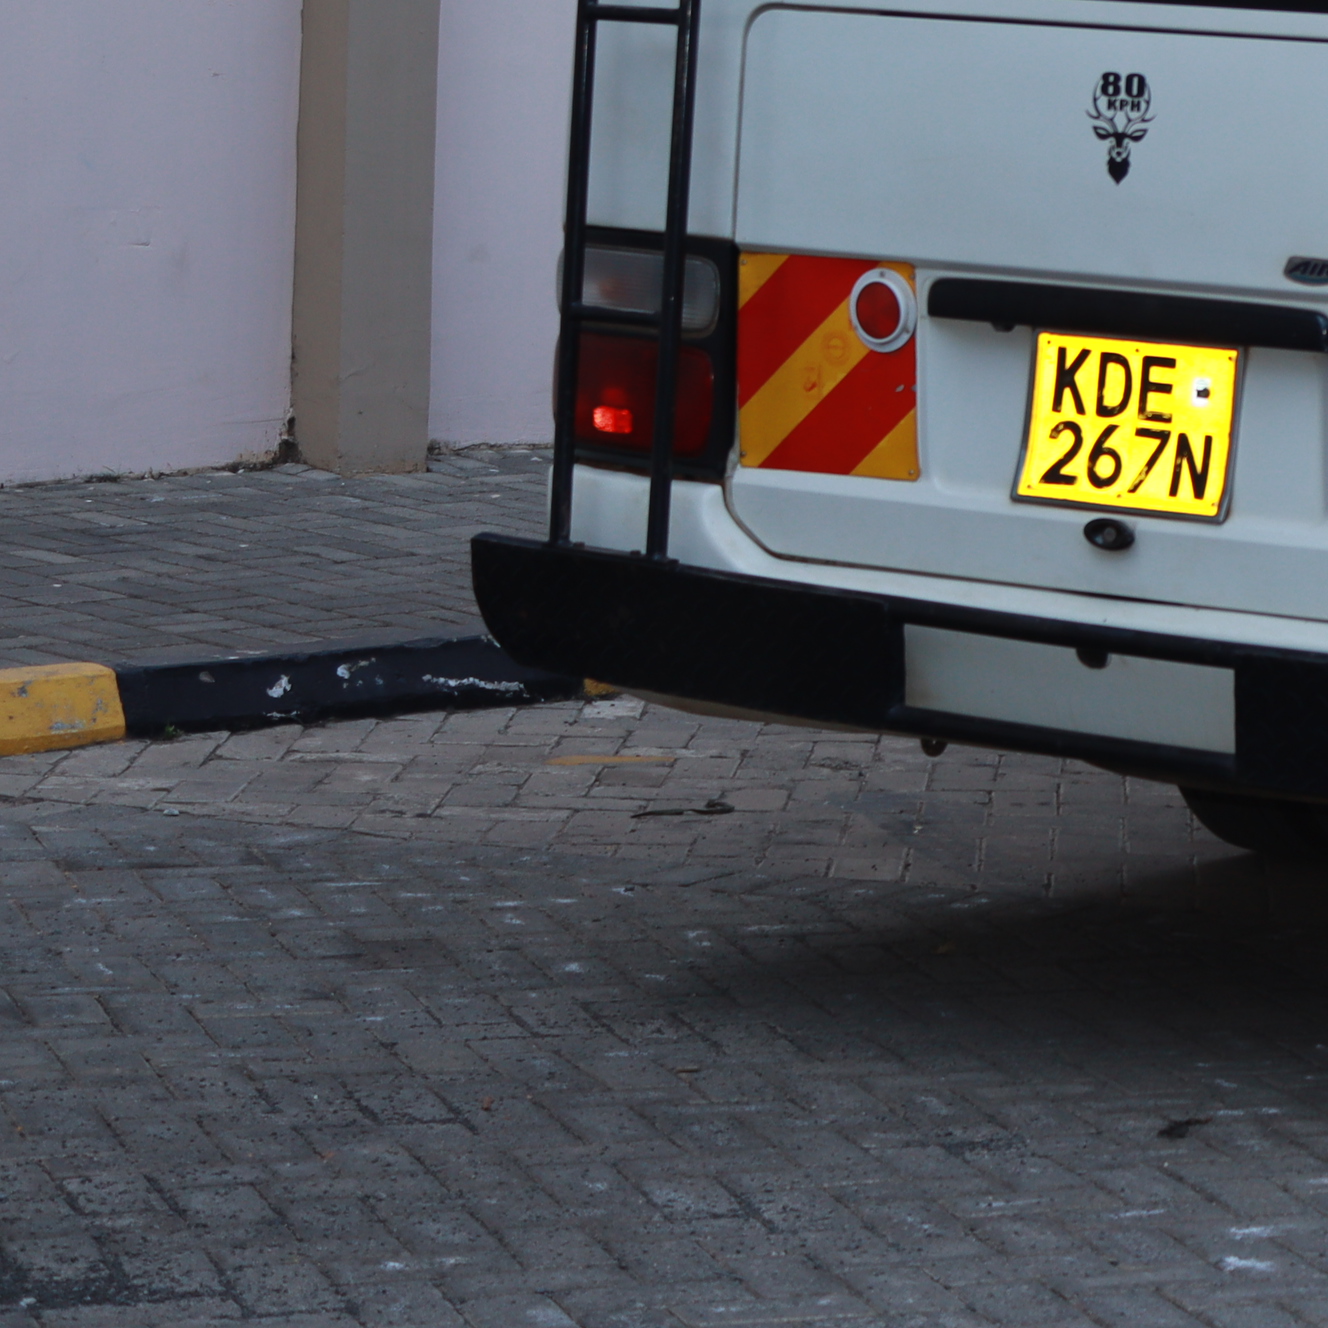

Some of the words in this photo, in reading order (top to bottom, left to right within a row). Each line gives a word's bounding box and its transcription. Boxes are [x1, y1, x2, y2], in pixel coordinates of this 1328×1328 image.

[1101, 72, 1146, 98] 80
[1106, 98, 1141, 113] KPH
[1052, 346, 1177, 423] KDE
[1039, 421, 1213, 500] 267N
